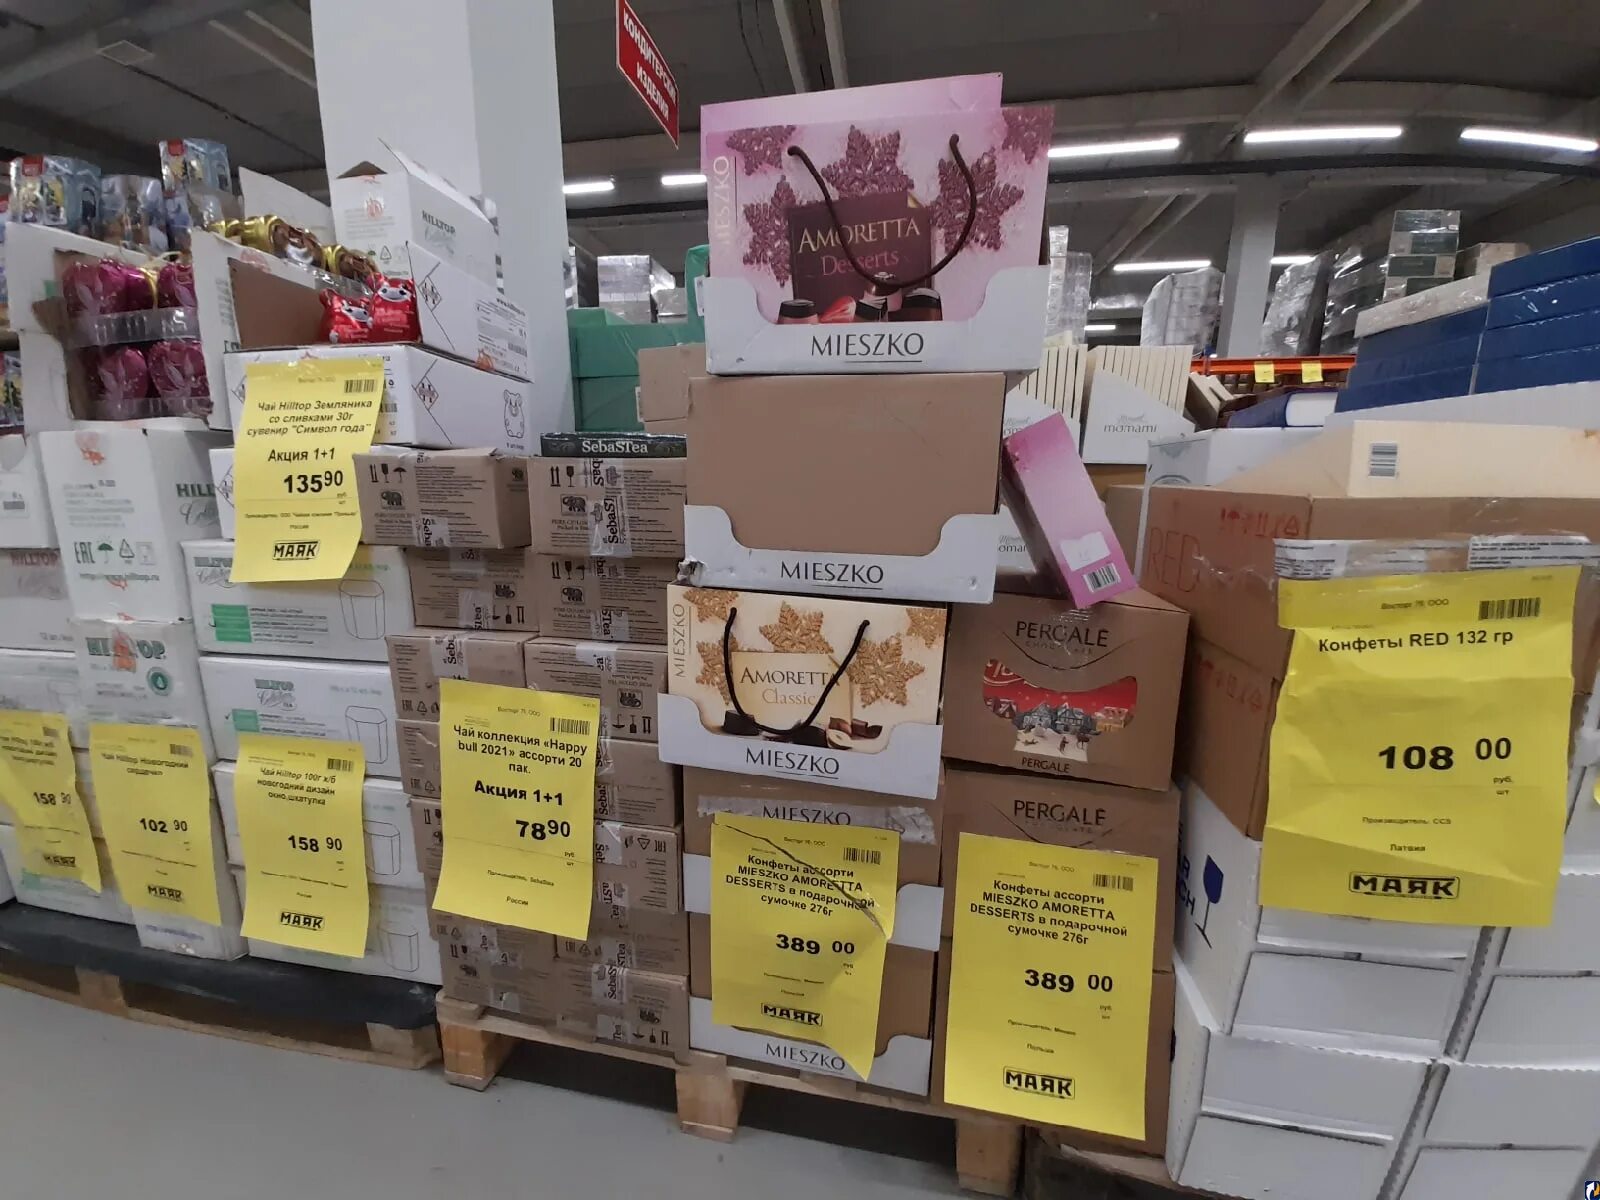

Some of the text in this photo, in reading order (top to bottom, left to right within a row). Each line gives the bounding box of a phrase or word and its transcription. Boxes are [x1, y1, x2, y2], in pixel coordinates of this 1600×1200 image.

[637, 61, 669, 120] ИЗДЕЛИЯ
[798, 217, 921, 253] AMORETTA
[821, 250, 899, 277] Desserts
[811, 332, 925, 357] MIESZKO
[258, 400, 372, 412] Чай Hilltop Земляника
[283, 414, 333, 422] сливками
[336, 412, 353, 421] 30г
[247, 427, 288, 436] сувенир
[268, 448, 335, 462] Акция 1+1
[582, 440, 648, 453] SebaSTea
[273, 541, 319, 558] МАЯК
[780, 561, 884, 583] MIESZKO
[672, 603, 687, 678] MIESZKO
[1016, 621, 1110, 647] PERGALE
[1319, 630, 1513, 653] Конфеты RED 132 гр
[740, 666, 840, 686] AMORETTA
[762, 687, 816, 706] Classic
[453, 724, 587, 756] Чай коллекция «Happy
[458, 740, 582, 768] bull 2021» ассорти 20
[746, 747, 840, 775] MIESZKO
[1378, 737, 1511, 770] 108 00
[509, 762, 531, 774] пак.
[1021, 756, 1070, 774] PERGALE
[34, 792, 56, 805] 158
[474, 780, 563, 806] Акция 1+1
[763, 804, 850, 825] MIESZKO
[1013, 800, 1107, 826] PERGALE
[139, 818, 188, 833] 102 90
[288, 835, 343, 852] 158 90
[738, 865, 789, 881] MIESZKO
[748, 854, 799, 873] Конфеты
[726, 875, 785, 893] DESSERTS
[789, 887, 796, 895] в
[993, 879, 1105, 905] Конфеты ассорти
[1353, 875, 1456, 897] МАЯК
[761, 894, 833, 917] сумочке 276г
[983, 892, 1115, 921] MIESZKO AMORETTA
[280, 912, 324, 930] МАЯК
[970, 903, 1127, 936] DESSERTS в подарочной
[776, 934, 855, 954] 389 00
[1008, 924, 1089, 945] сумочке 276г
[1024, 969, 1113, 992] 389 00
[763, 1003, 821, 1026] МАЯК
[766, 1043, 845, 1071] MIESZKO
[1005, 1070, 1073, 1097] МАЯК
